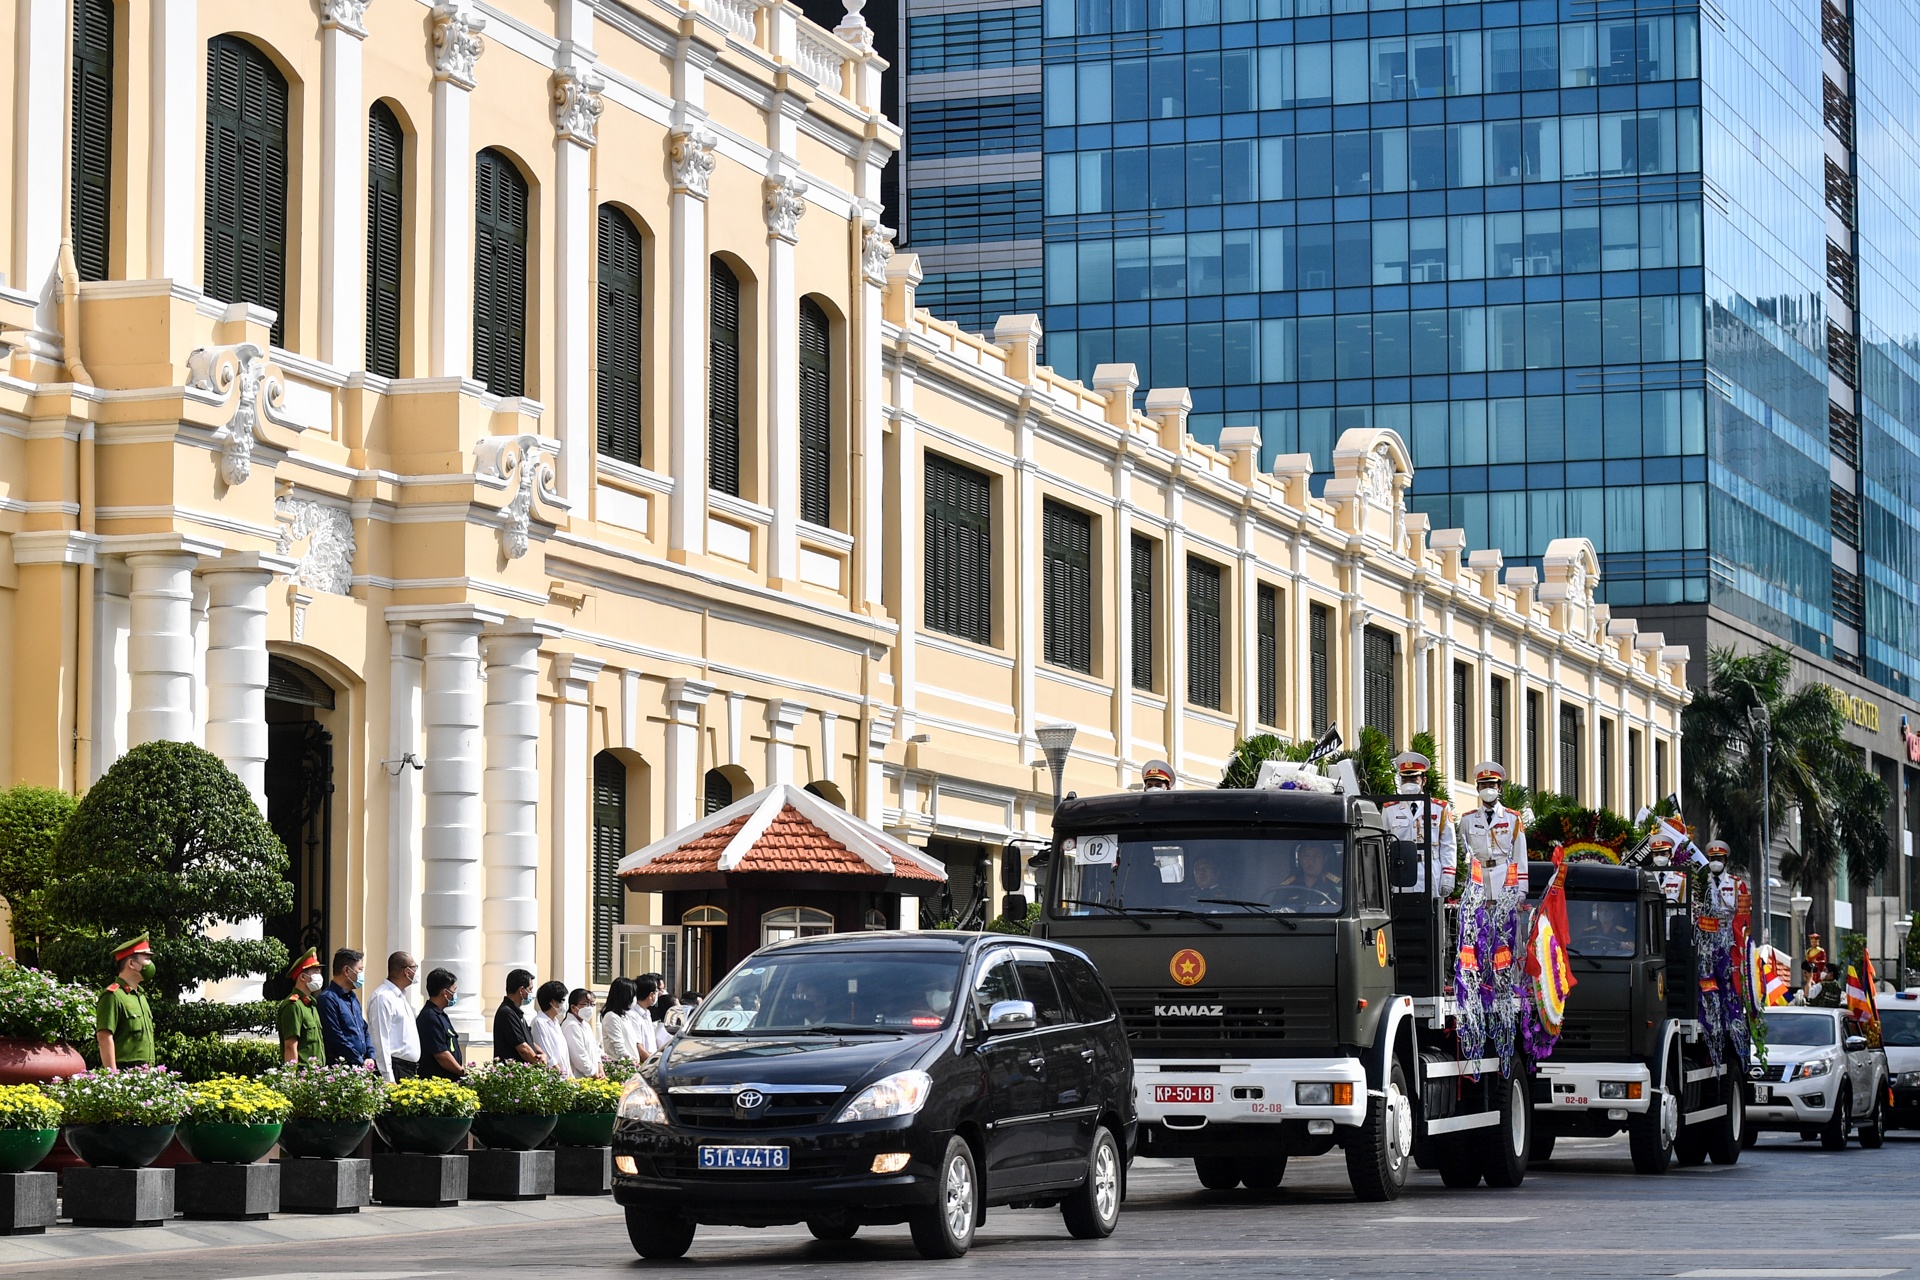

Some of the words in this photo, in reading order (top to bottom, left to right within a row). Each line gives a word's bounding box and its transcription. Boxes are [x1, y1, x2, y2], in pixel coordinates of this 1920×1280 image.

[1853, 696, 1880, 732] CENTER
[1090, 843, 1103, 856] 02
[1154, 1005, 1224, 1017] KAMAZ
[716, 1017, 734, 1028] 01
[1156, 1087, 1212, 1101] KP-50-18
[1565, 1096, 1588, 1104] 02-08
[1251, 1103, 1282, 1113] 02-08
[704, 1149, 784, 1167] 51A-4418
